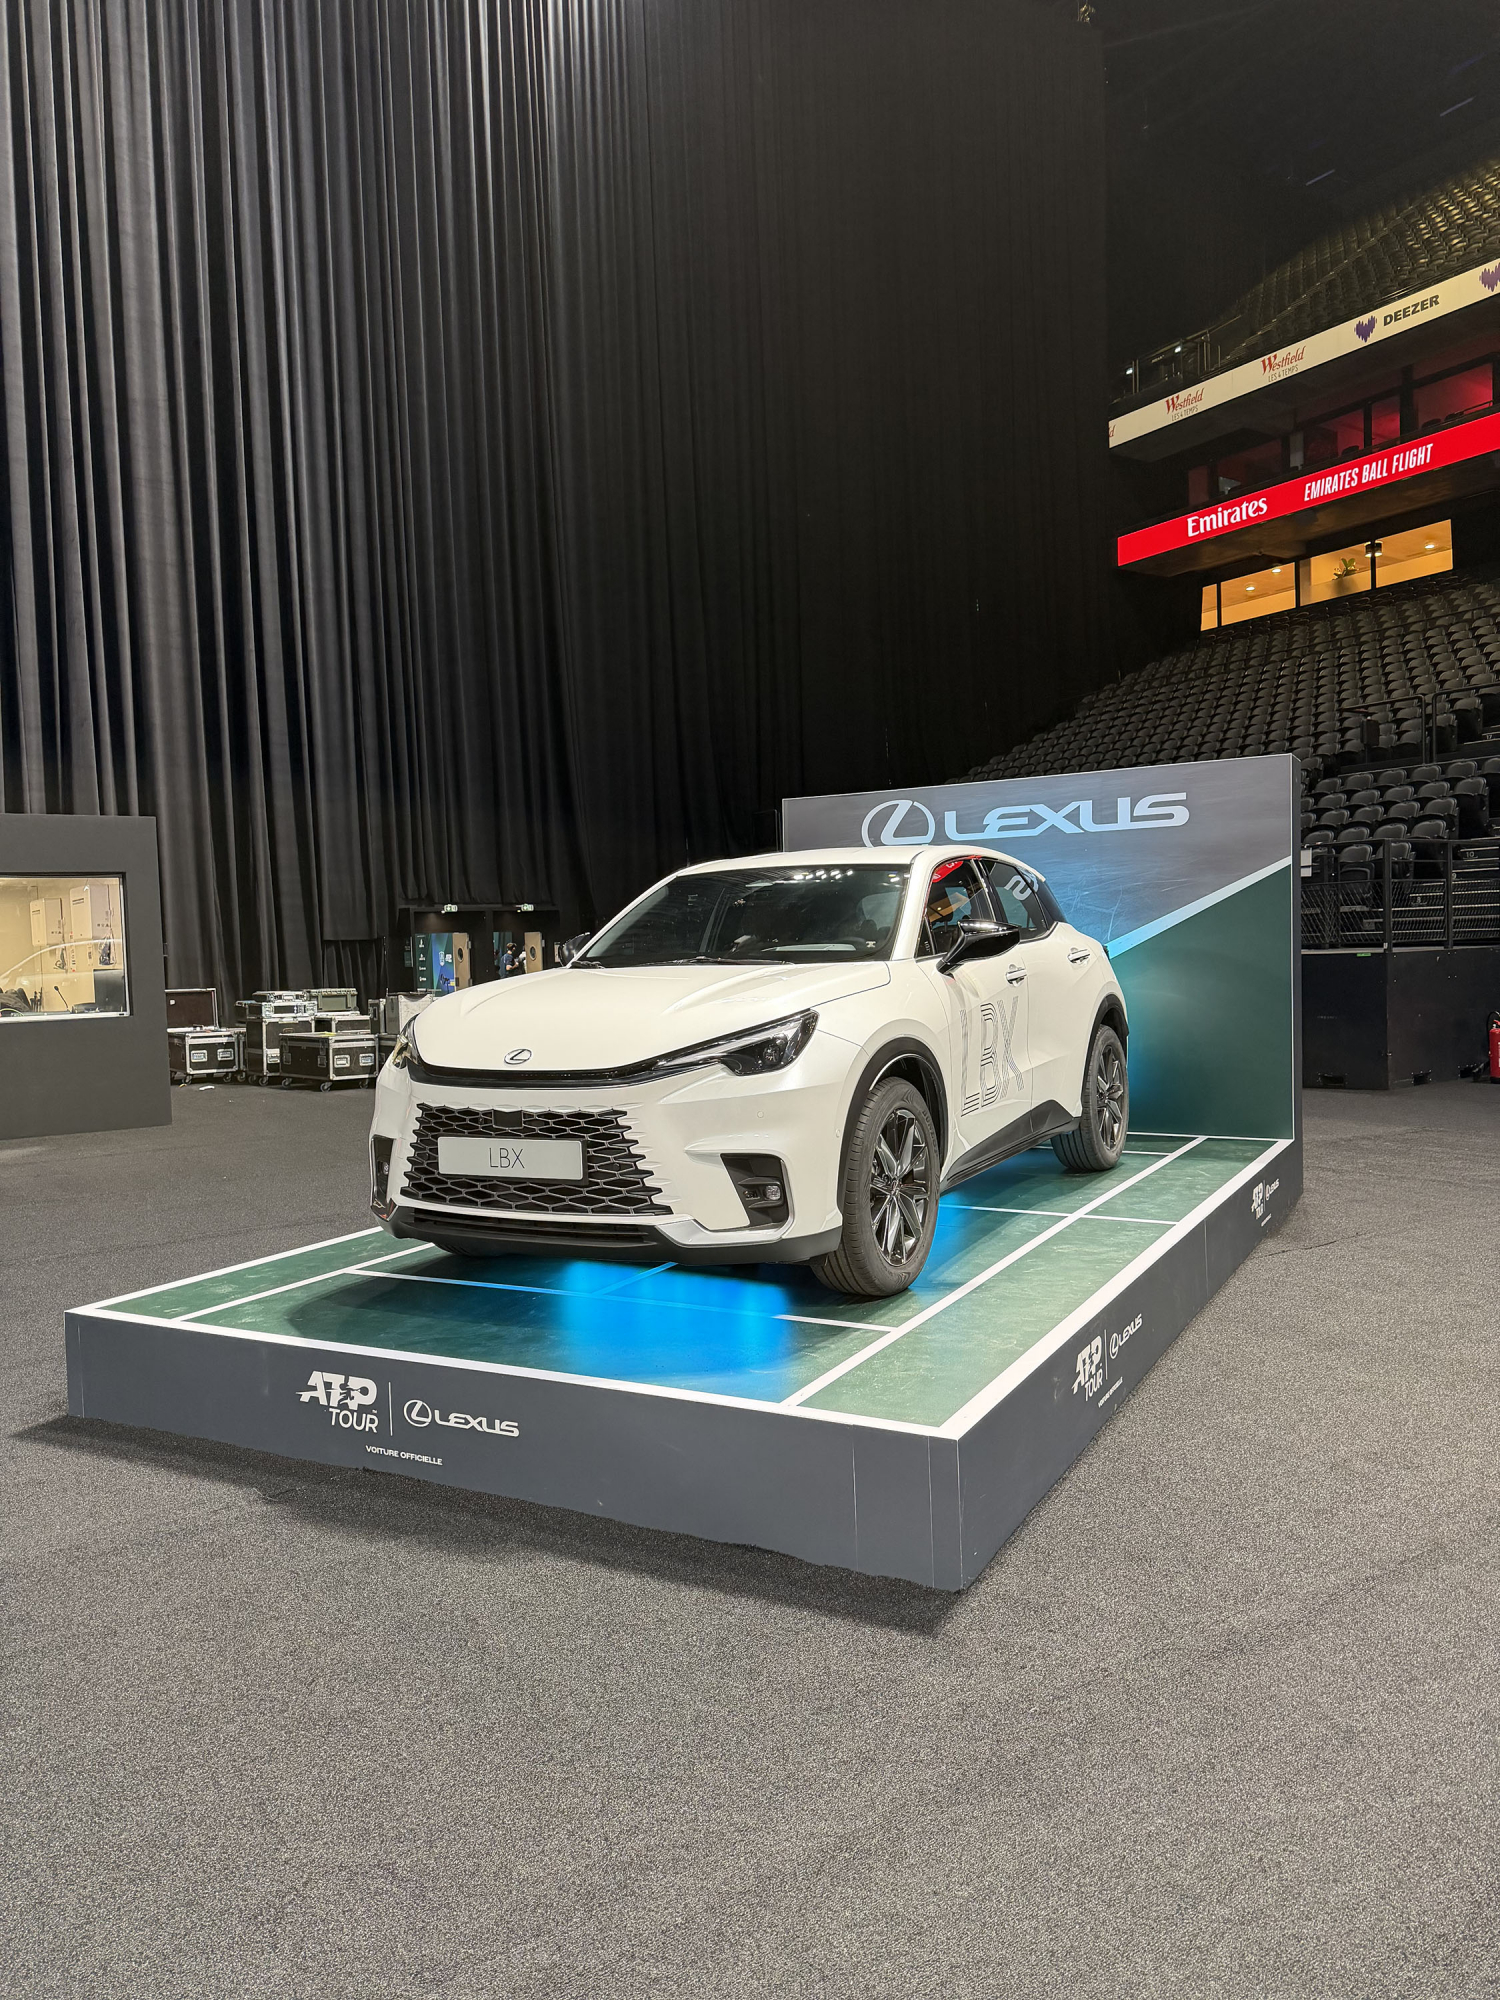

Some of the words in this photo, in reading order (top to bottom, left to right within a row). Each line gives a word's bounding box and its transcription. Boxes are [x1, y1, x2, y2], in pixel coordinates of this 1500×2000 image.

[1383, 294, 1440, 327] DEEZER
[1261, 345, 1306, 375] Westfield
[1268, 371, 1278, 382] LES
[1282, 364, 1299, 377] TEMPS
[1165, 387, 1205, 415] Westfield
[1171, 411, 1180, 421] LES
[1184, 404, 1199, 416] TEMPS
[1304, 467, 1358, 502] EMIRATES
[1362, 457, 1389, 484] BALL
[1391, 443, 1434, 475] FLIGHT
[1187, 496, 1268, 538] Emirates
[944, 792, 1190, 841] LEXUS
[960, 996, 1025, 1117] LBX
[488, 1147, 525, 1169] LBX
[1118, 1313, 1142, 1346] LEXUS
[1071, 1335, 1102, 1395] ATP
[296, 1370, 377, 1410] ATP
[1085, 1369, 1103, 1401] TOUR
[329, 1407, 379, 1433] TOUR
[434, 1409, 520, 1437] LEXUS
[365, 1444, 400, 1458] VOITURE
[400, 1451, 443, 1466] OFFICIELLE
